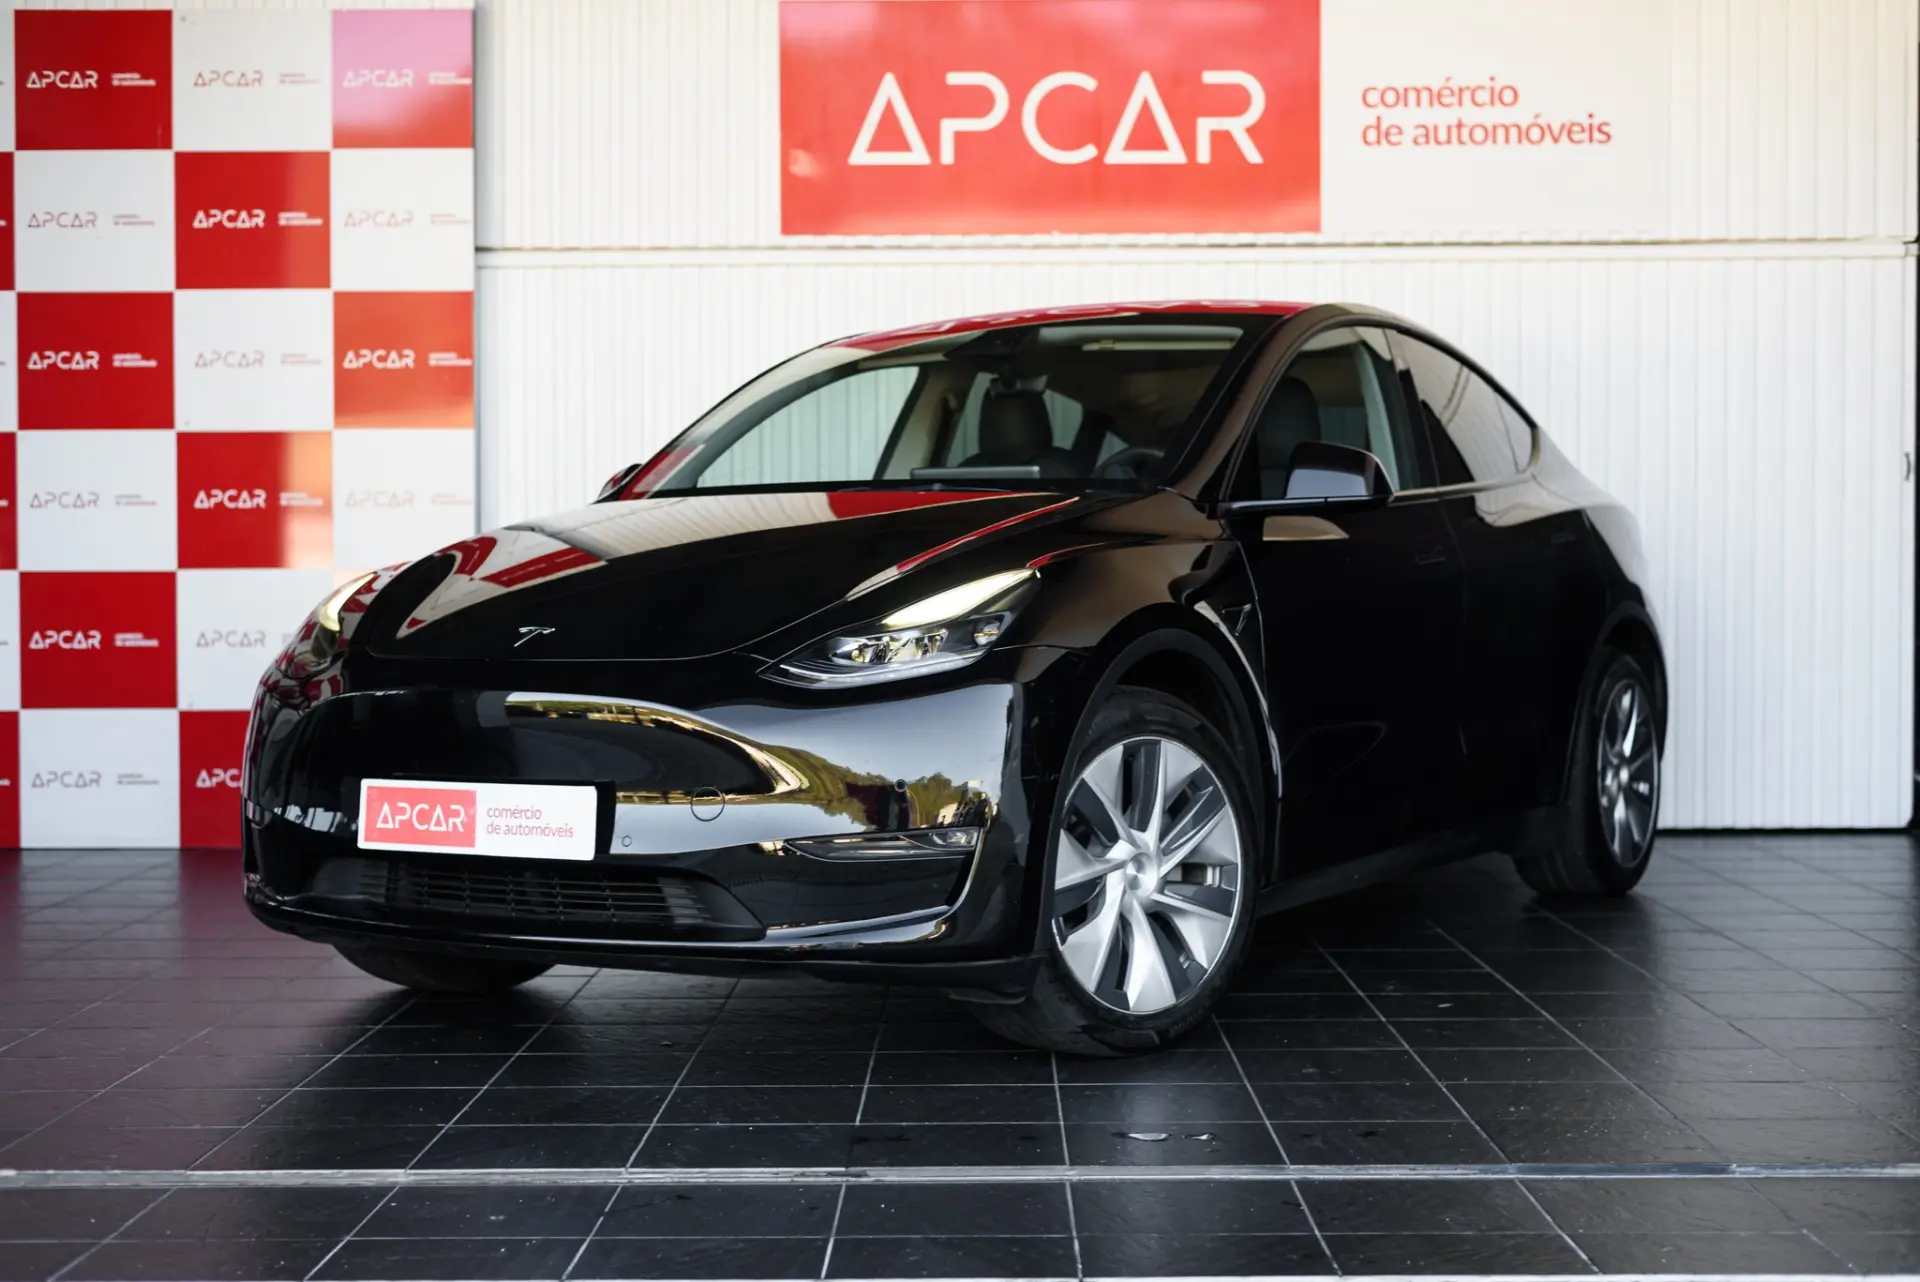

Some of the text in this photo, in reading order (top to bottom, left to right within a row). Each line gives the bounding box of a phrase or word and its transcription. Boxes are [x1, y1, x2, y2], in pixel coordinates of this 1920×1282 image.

[26, 70, 98, 88] APCAR
[193, 70, 264, 88] APCAR
[343, 69, 415, 88] APCAR
[1361, 76, 1519, 108] comércio
[848, 71, 1266, 165] APCAR
[1362, 114, 1612, 146] de automóveis
[27, 210, 98, 228] APCAR
[193, 209, 265, 229] APCAR
[343, 210, 414, 228] APCAR
[27, 351, 99, 370] APCAR
[195, 350, 265, 368] APCAR
[342, 349, 415, 369] APCAR
[29, 491, 100, 509] APCAR
[193, 489, 266, 509] APCAR
[29, 630, 101, 649] APCAR
[196, 630, 266, 648] APCAR
[31, 770, 102, 788] APCAR
[195, 768, 242, 788] APC
[376, 802, 466, 832] APCAR
[486, 805, 542, 820] comércio
[486, 820, 574, 838] de automóveis
